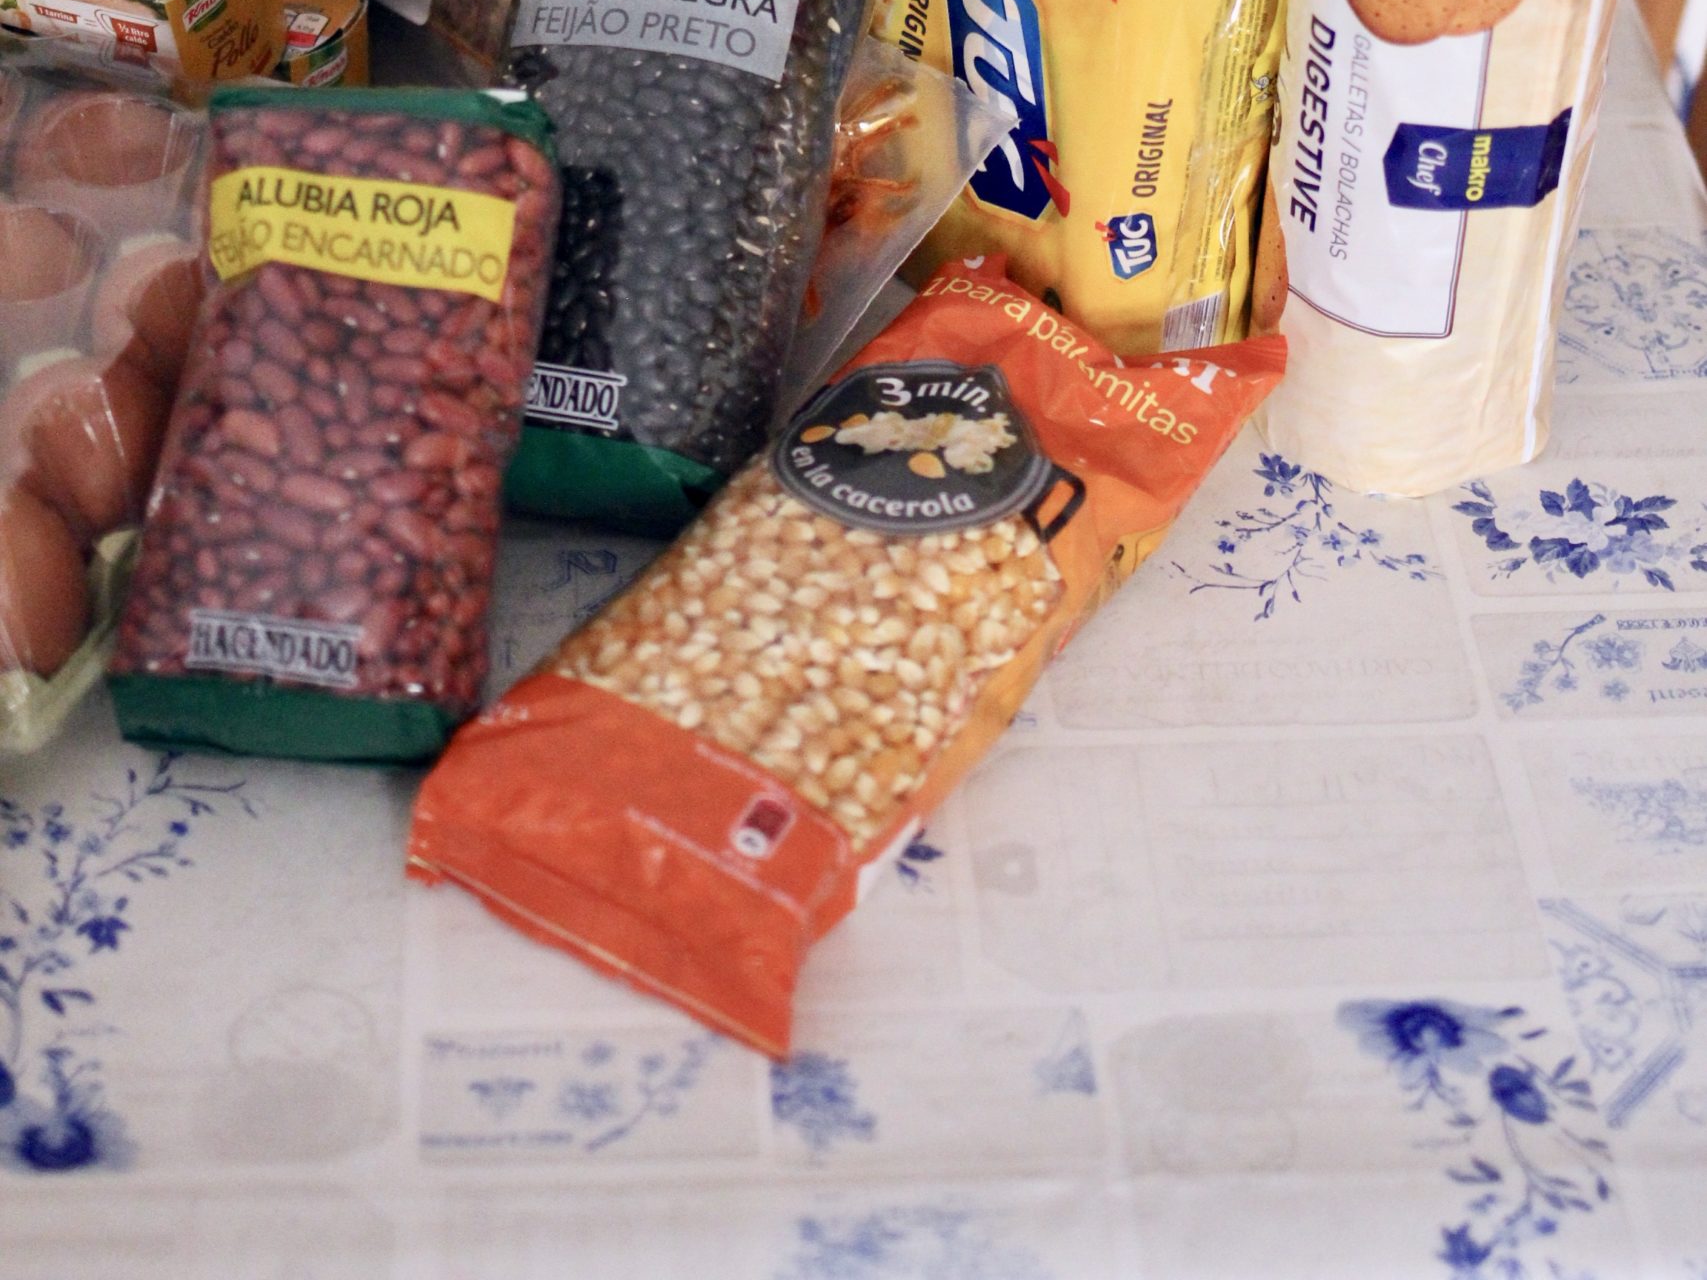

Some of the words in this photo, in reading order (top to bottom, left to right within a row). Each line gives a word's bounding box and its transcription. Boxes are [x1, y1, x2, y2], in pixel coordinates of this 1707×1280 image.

[531, 0, 630, 43] FEIJÃO
[639, 11, 757, 58] PRETO
[1340, 32, 1374, 141] GALLETAS
[1131, 97, 1174, 199] ORIGINAL
[1289, 13, 1337, 234] DIGESTIVE
[1407, 139, 1449, 198] Chef
[1465, 134, 1493, 202] makro
[235, 177, 359, 221] ALUBIA
[370, 192, 461, 236] ROJA
[1328, 152, 1361, 263] BOLACHAS
[281, 222, 502, 286] ENCARNADO
[1118, 218, 1150, 275] TUC
[938, 276, 1033, 323] para
[876, 376, 912, 407] 3
[916, 376, 990, 413] min.
[791, 444, 816, 469] en
[803, 464, 835, 489] la
[832, 483, 976, 519] cacerola
